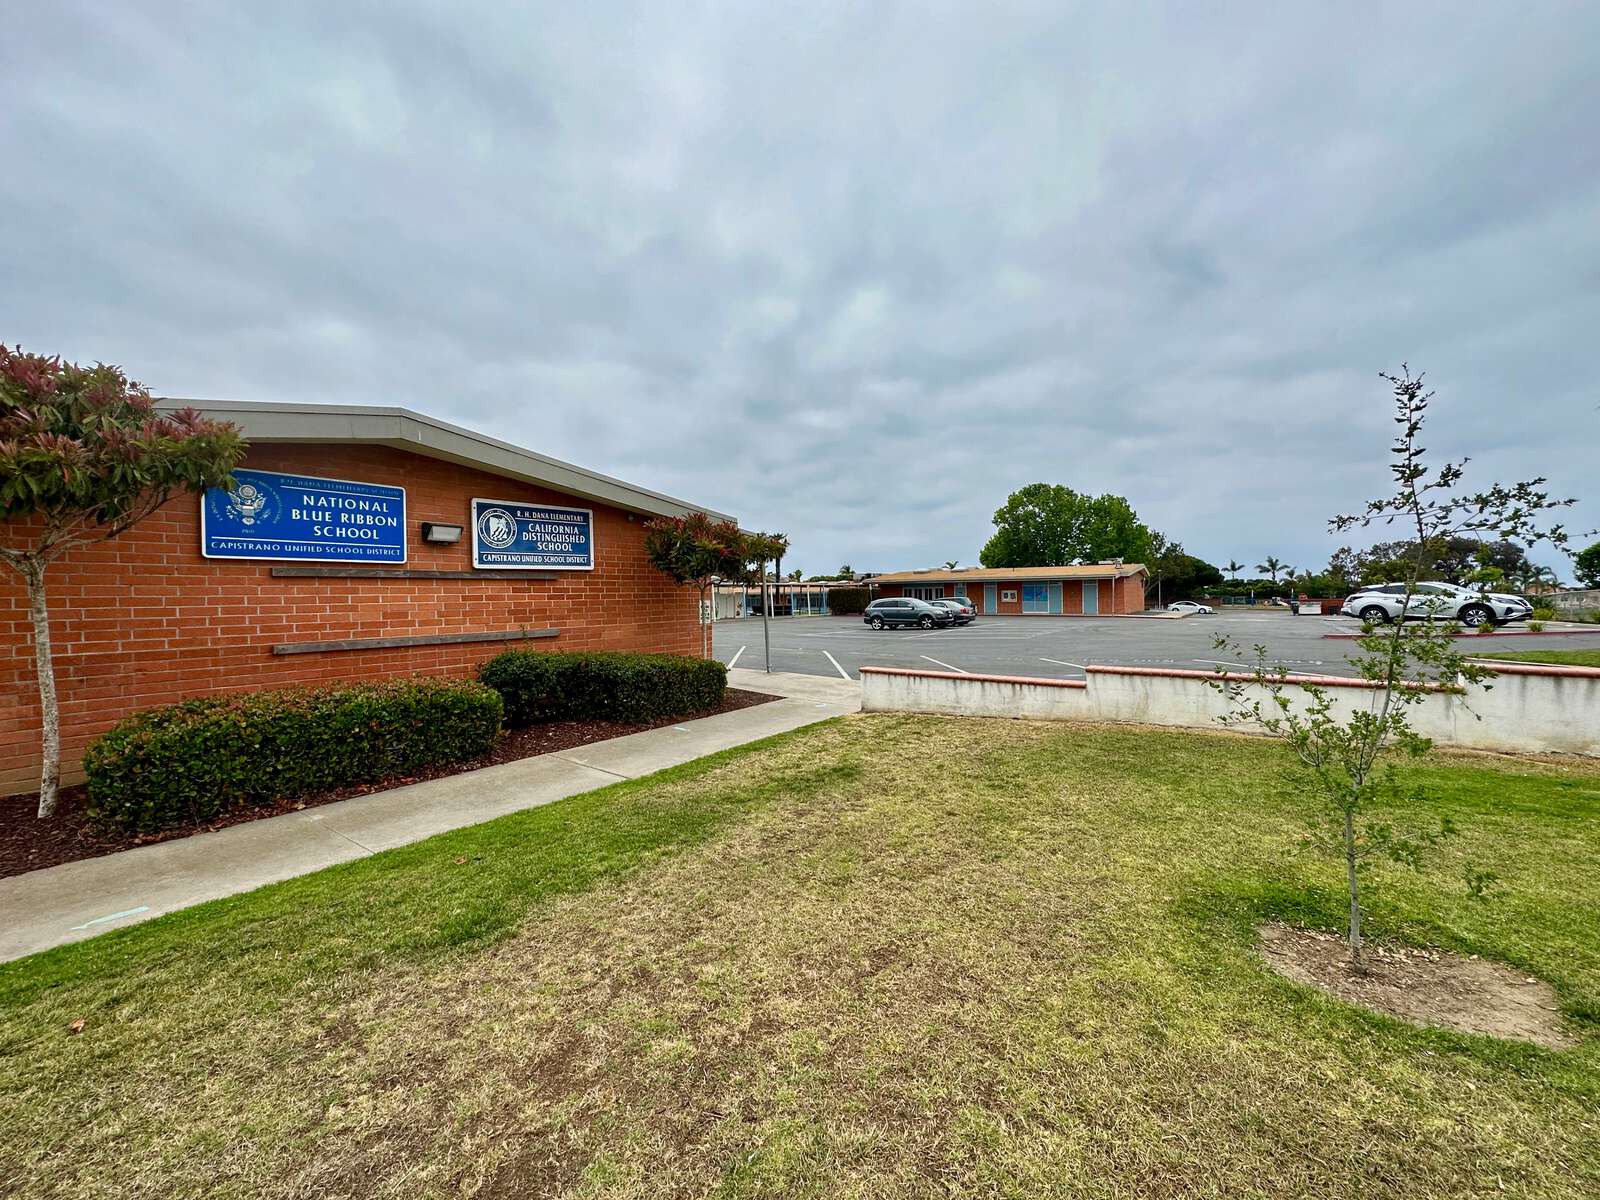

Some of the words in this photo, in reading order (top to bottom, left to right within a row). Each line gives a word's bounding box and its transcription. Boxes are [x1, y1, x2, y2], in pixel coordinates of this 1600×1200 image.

[303, 495, 389, 513] NATIONAL
[292, 508, 333, 522] BLUE
[340, 512, 397, 527] RIBBON
[550, 513, 583, 522] ELEMENTARY
[314, 526, 380, 540] SCHOOL
[529, 524, 579, 535] CALIFORNIA
[523, 533, 586, 544] DISTINGUISHED
[211, 541, 281, 552] CAPISTRANO
[285, 545, 323, 553] UNIFIED
[326, 546, 364, 555] SCHOOL
[367, 548, 401, 556] DISTRICT
[537, 543, 573, 552] SCHOOL
[483, 554, 520, 562] CAPISTRANO
[522, 555, 542, 563] UNIFIED
[543, 555, 565, 563] SCHOOL
[566, 556, 587, 564] DISTRICT
